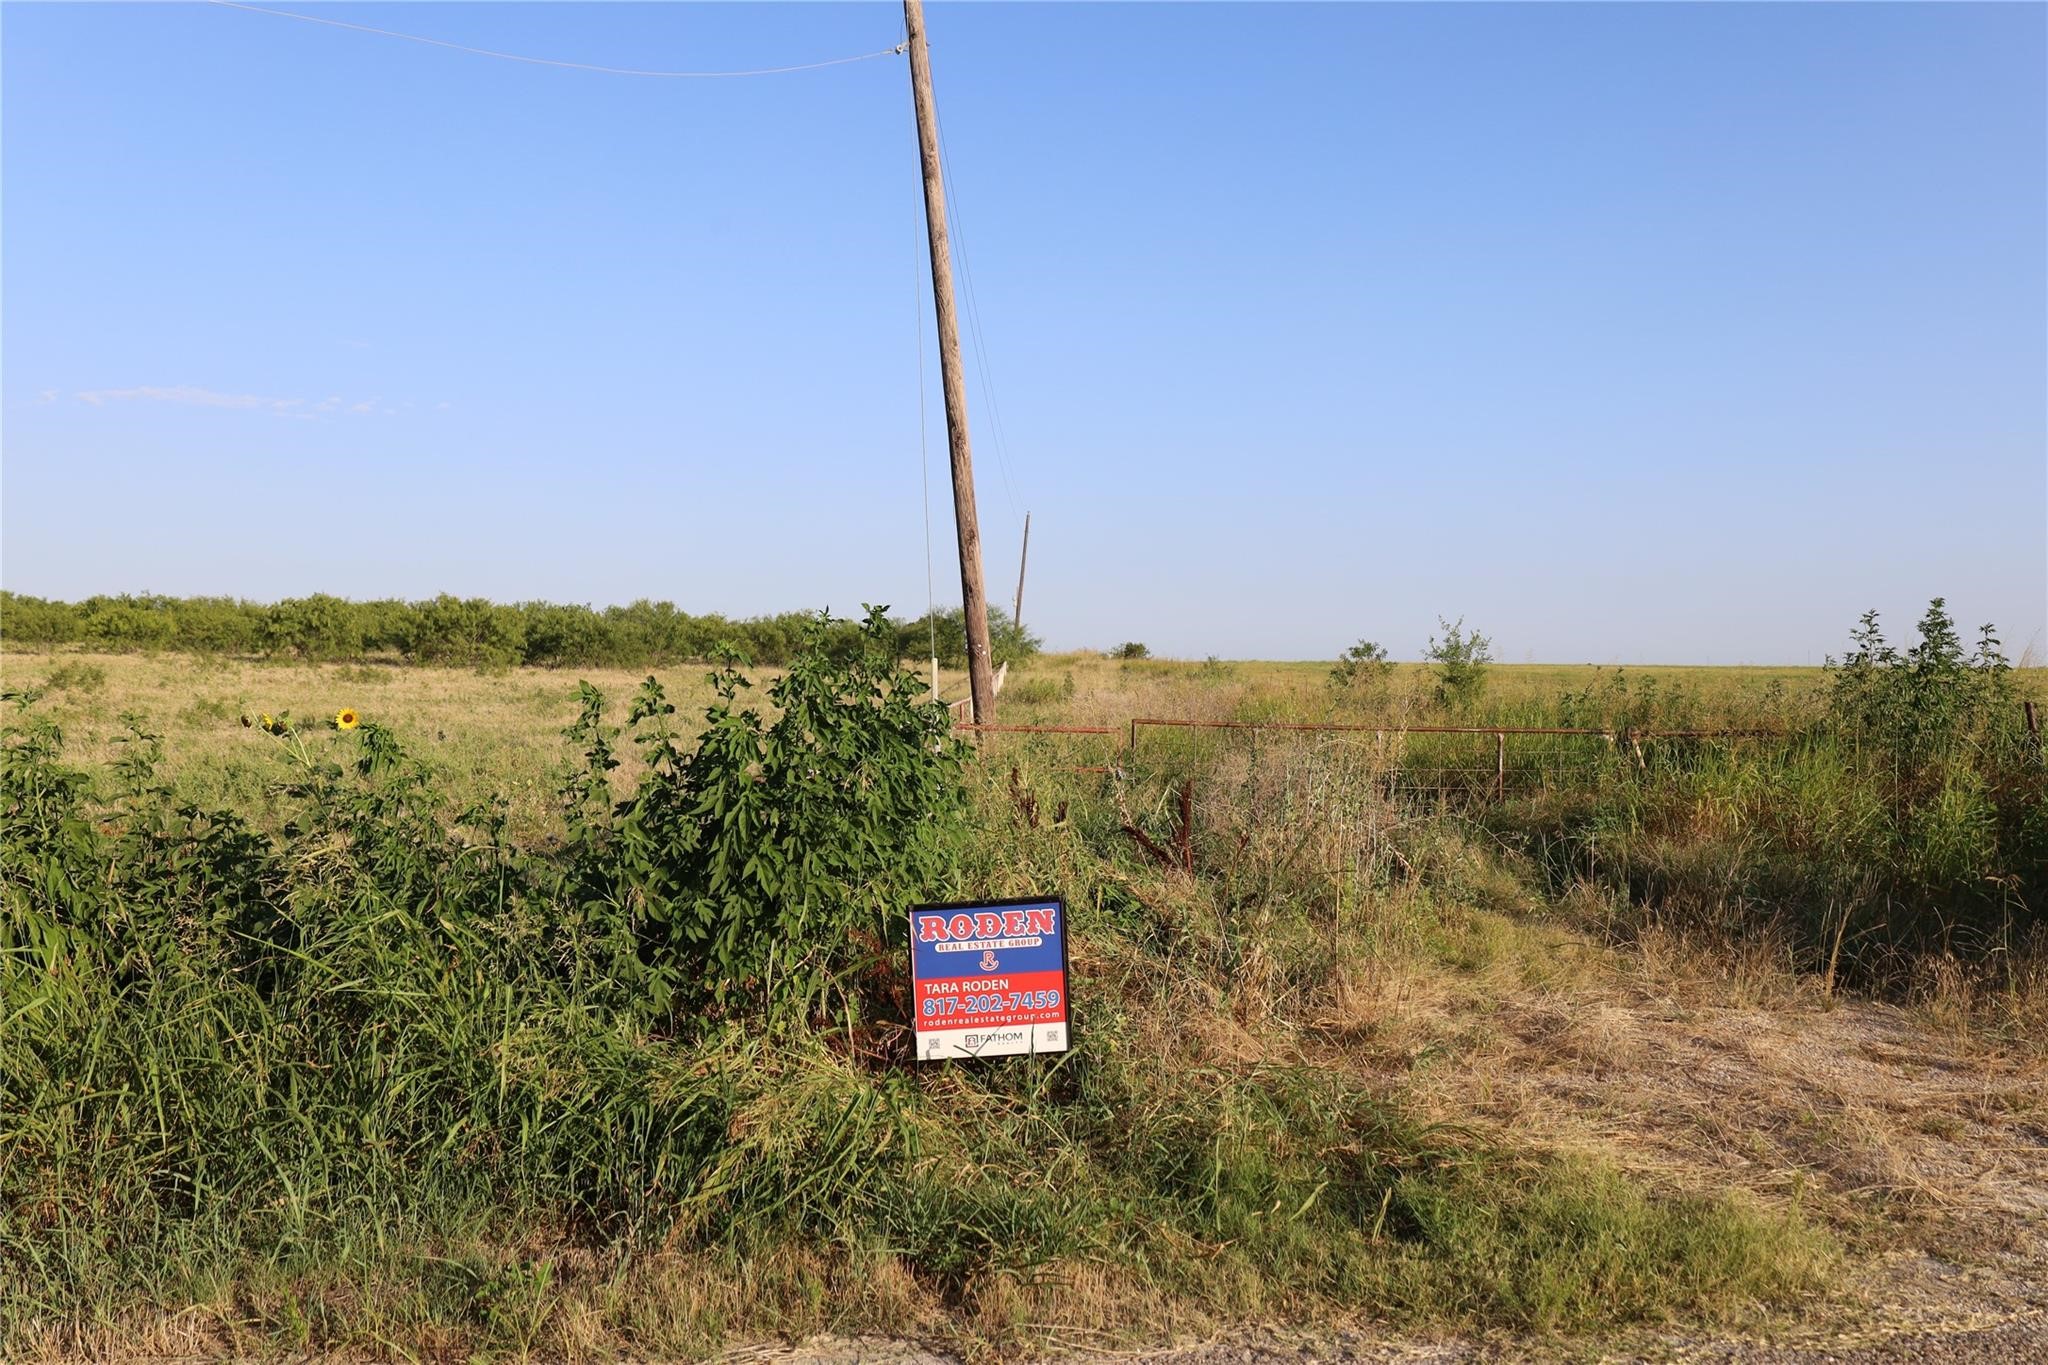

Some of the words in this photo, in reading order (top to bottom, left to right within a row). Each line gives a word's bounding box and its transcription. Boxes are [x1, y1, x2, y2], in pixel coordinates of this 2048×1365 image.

[919, 909, 1055, 942] RODEN
[938, 942, 963, 951] REAL
[968, 940, 1006, 949] ESTATE
[1008, 937, 1040, 946] GROUP
[924, 983, 959, 994] TARA
[962, 979, 1009, 992] RODEN
[923, 990, 1060, 1016] 817-202-7459
[980, 1032, 1023, 1043] FATHOM
